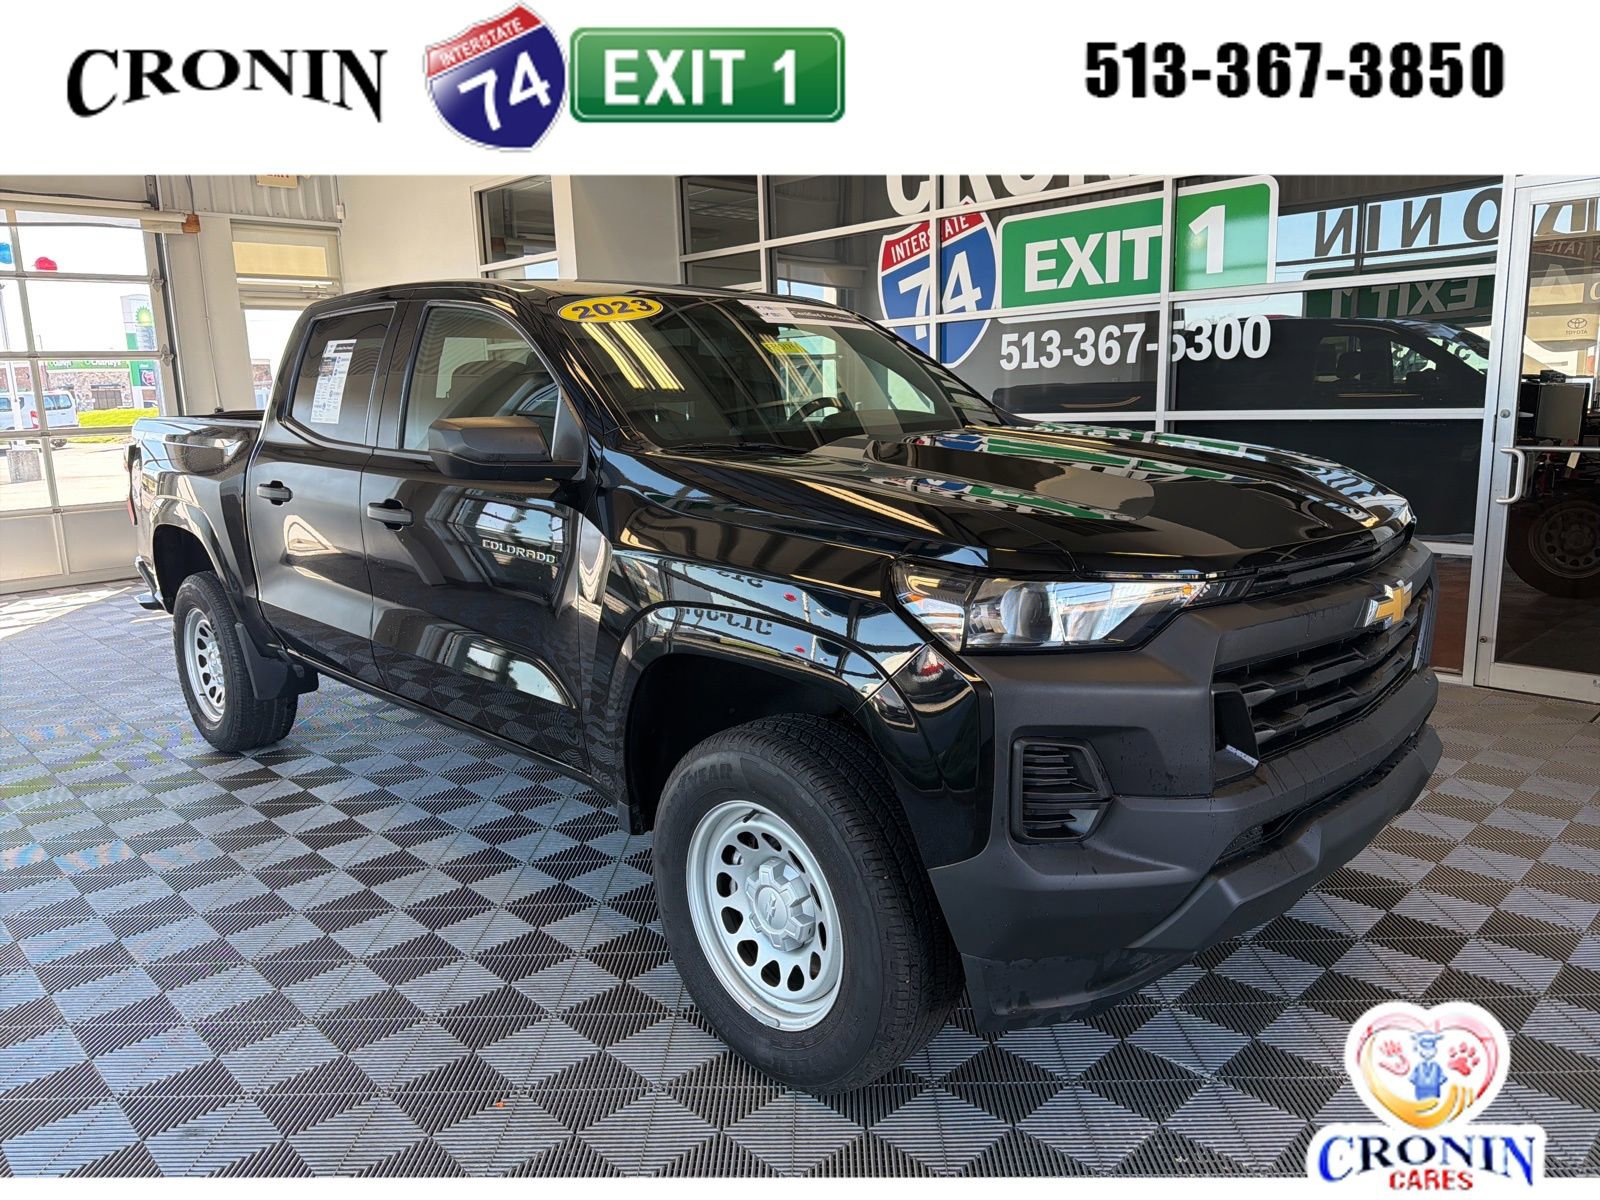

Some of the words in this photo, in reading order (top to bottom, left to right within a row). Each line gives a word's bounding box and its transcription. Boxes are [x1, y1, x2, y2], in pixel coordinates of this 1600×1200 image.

[1025, 225, 1163, 292] EXIT
[1188, 204, 1226, 274] 1
[571, 299, 653, 319] 2023
[898, 251, 982, 341] 74
[1000, 314, 1272, 371] 513-367-5300
[482, 539, 556, 564] COLORADO
